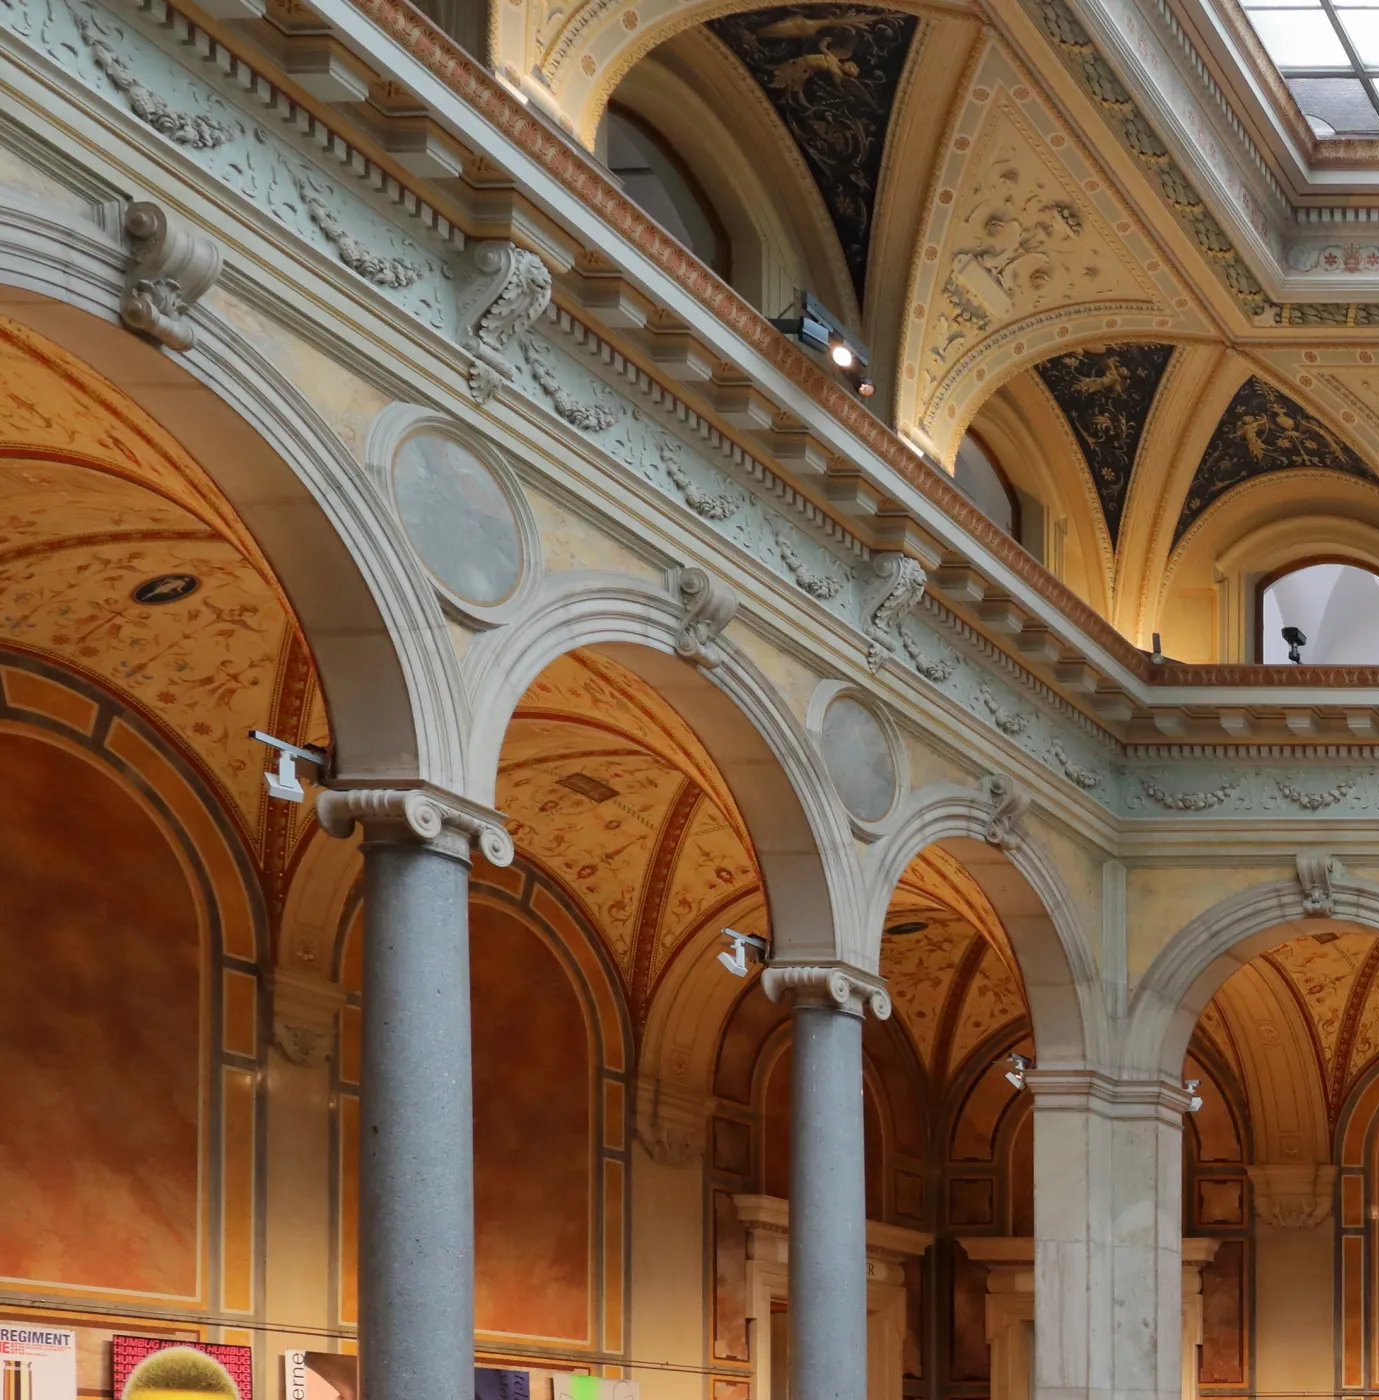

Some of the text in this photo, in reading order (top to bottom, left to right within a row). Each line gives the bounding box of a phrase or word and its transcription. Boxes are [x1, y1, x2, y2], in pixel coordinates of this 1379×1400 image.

[1, 1329, 70, 1346] REGIMENT
[114, 1335, 159, 1348] HUMBUG
[207, 1345, 250, 1356] HUMBUG
